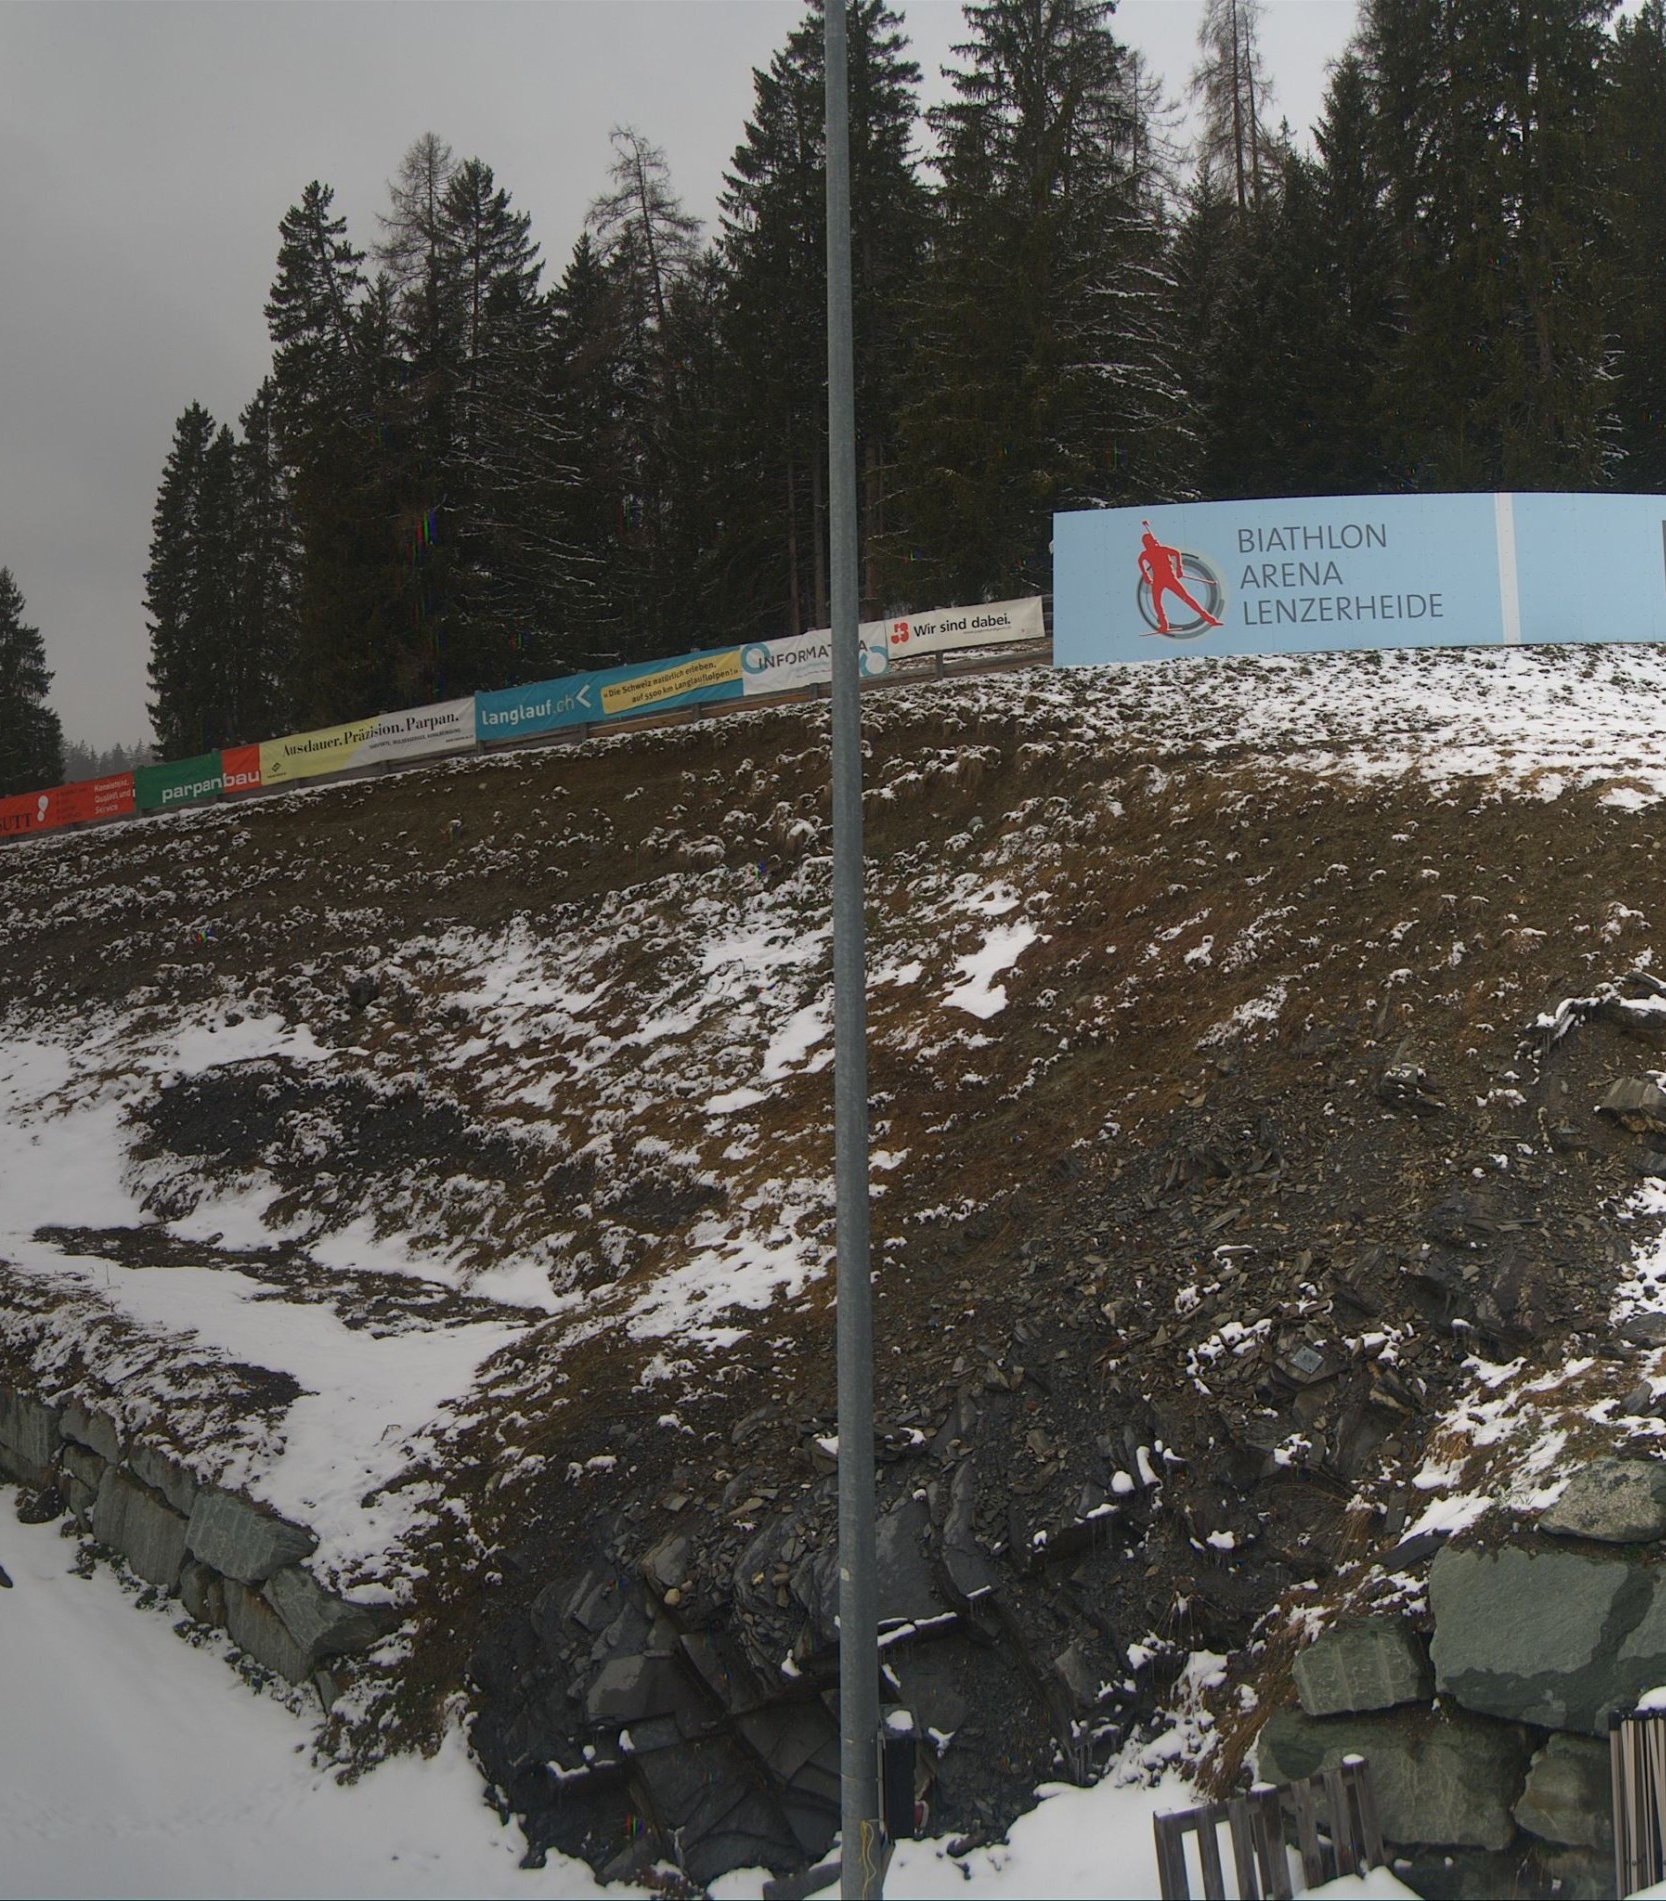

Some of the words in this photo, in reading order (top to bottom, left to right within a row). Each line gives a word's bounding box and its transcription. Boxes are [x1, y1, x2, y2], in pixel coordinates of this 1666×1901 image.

[1238, 524, 1386, 554] BIATHLON
[1240, 561, 1343, 589] ARENA
[1243, 594, 1444, 625] LENZERHEIDE
[914, 623, 936, 638] Wir
[940, 618, 967, 632] sind
[971, 613, 1011, 629] dabei.
[759, 640, 868, 670] INFORMAA
[622, 679, 652, 693] Schweiz
[653, 671, 684, 685] natürlich
[632, 692, 644, 703] auf
[645, 689, 661, 701] 5500
[662, 685, 674, 694] km
[482, 694, 575, 725] langlauf.ch
[282, 739, 343, 757] Ausdauer.
[343, 725, 404, 747] Präzision.
[405, 711, 459, 732] Parpan.
[119, 789, 131, 799] und
